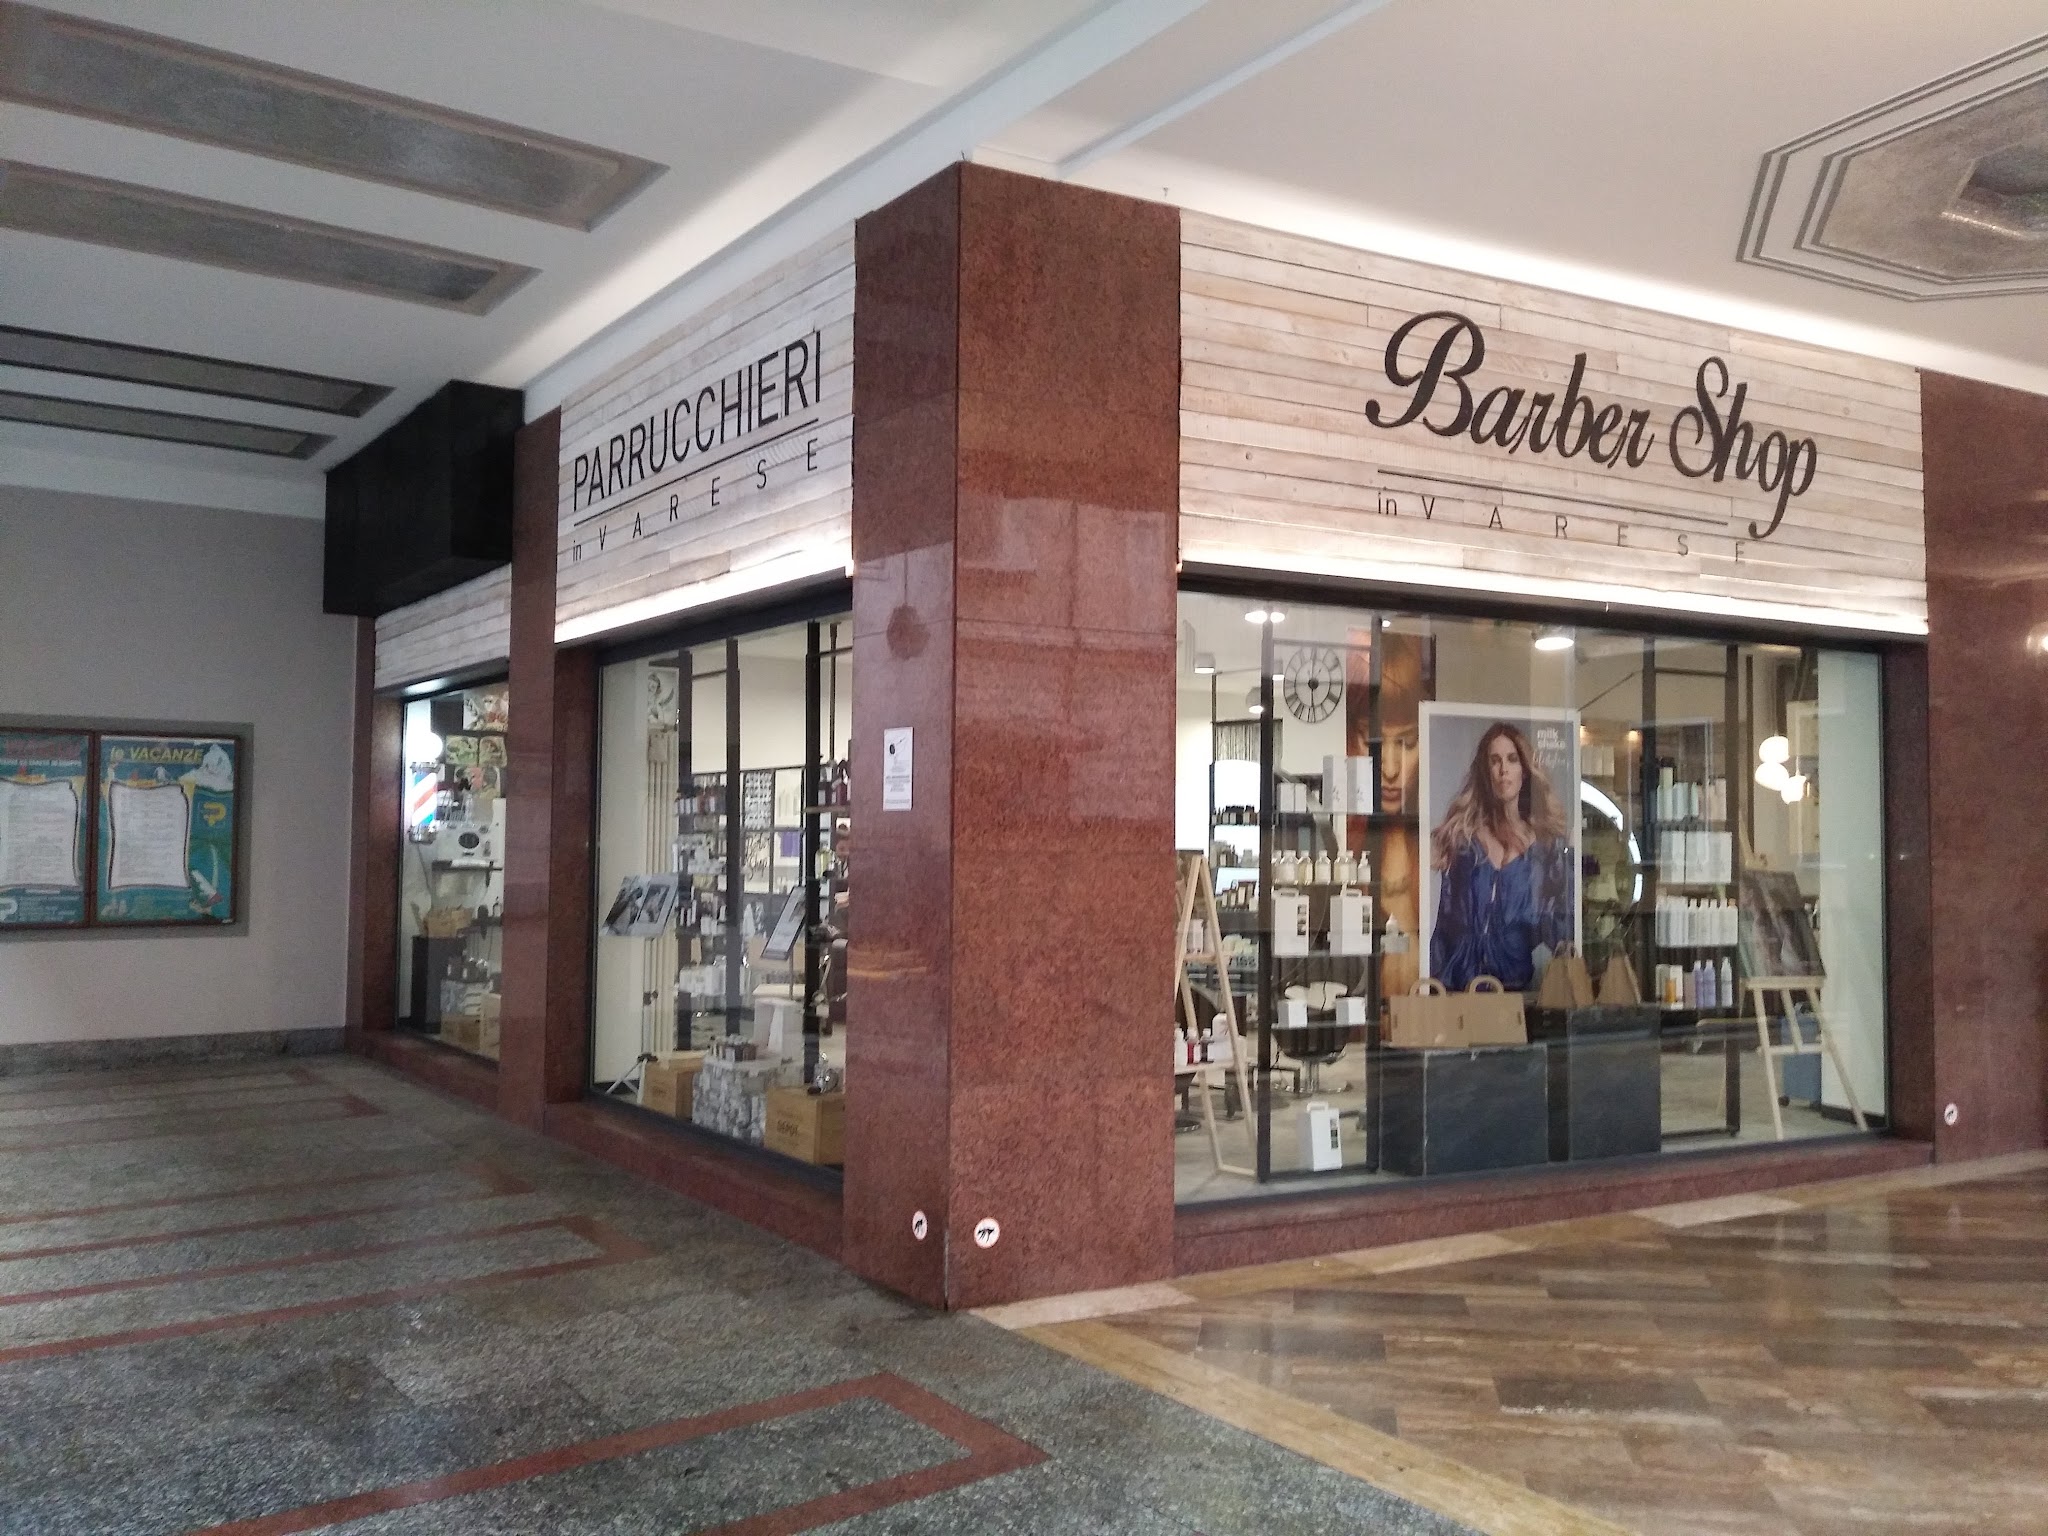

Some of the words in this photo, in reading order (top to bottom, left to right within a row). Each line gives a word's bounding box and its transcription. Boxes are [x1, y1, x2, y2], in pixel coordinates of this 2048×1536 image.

[573, 330, 821, 512] PARRUCCHIERI
[1365, 310, 1655, 469] Barber
[1668, 355, 1818, 539] Shop
[572, 540, 582, 562] in
[599, 438, 818, 550] VARESE
[1377, 486, 1398, 516] in
[1420, 496, 1746, 564] VARESE
